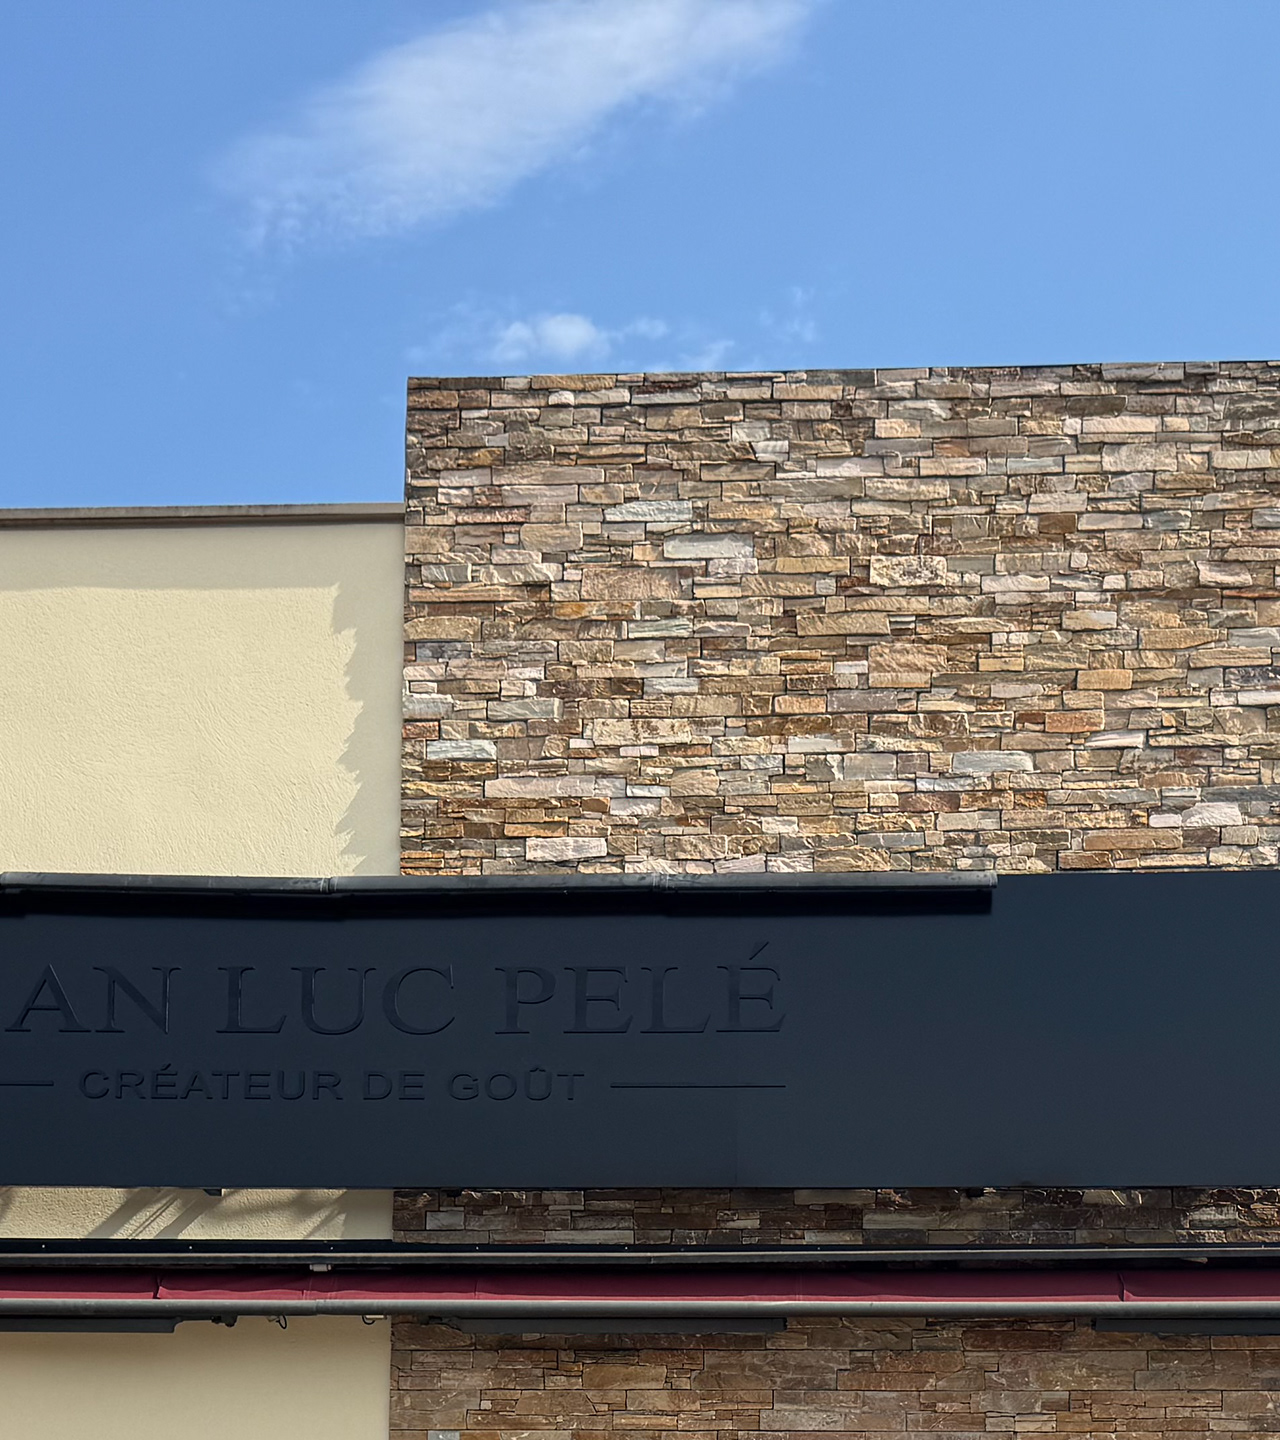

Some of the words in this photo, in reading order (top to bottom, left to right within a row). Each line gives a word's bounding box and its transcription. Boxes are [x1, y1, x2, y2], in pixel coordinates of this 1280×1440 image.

[216, 964, 456, 1035] LUC
[494, 940, 787, 1034] PELÉ
[77, 1063, 343, 1101] CRÉATEUR
[361, 1069, 425, 1101] DE
[446, 1063, 586, 1102] GOÛT
